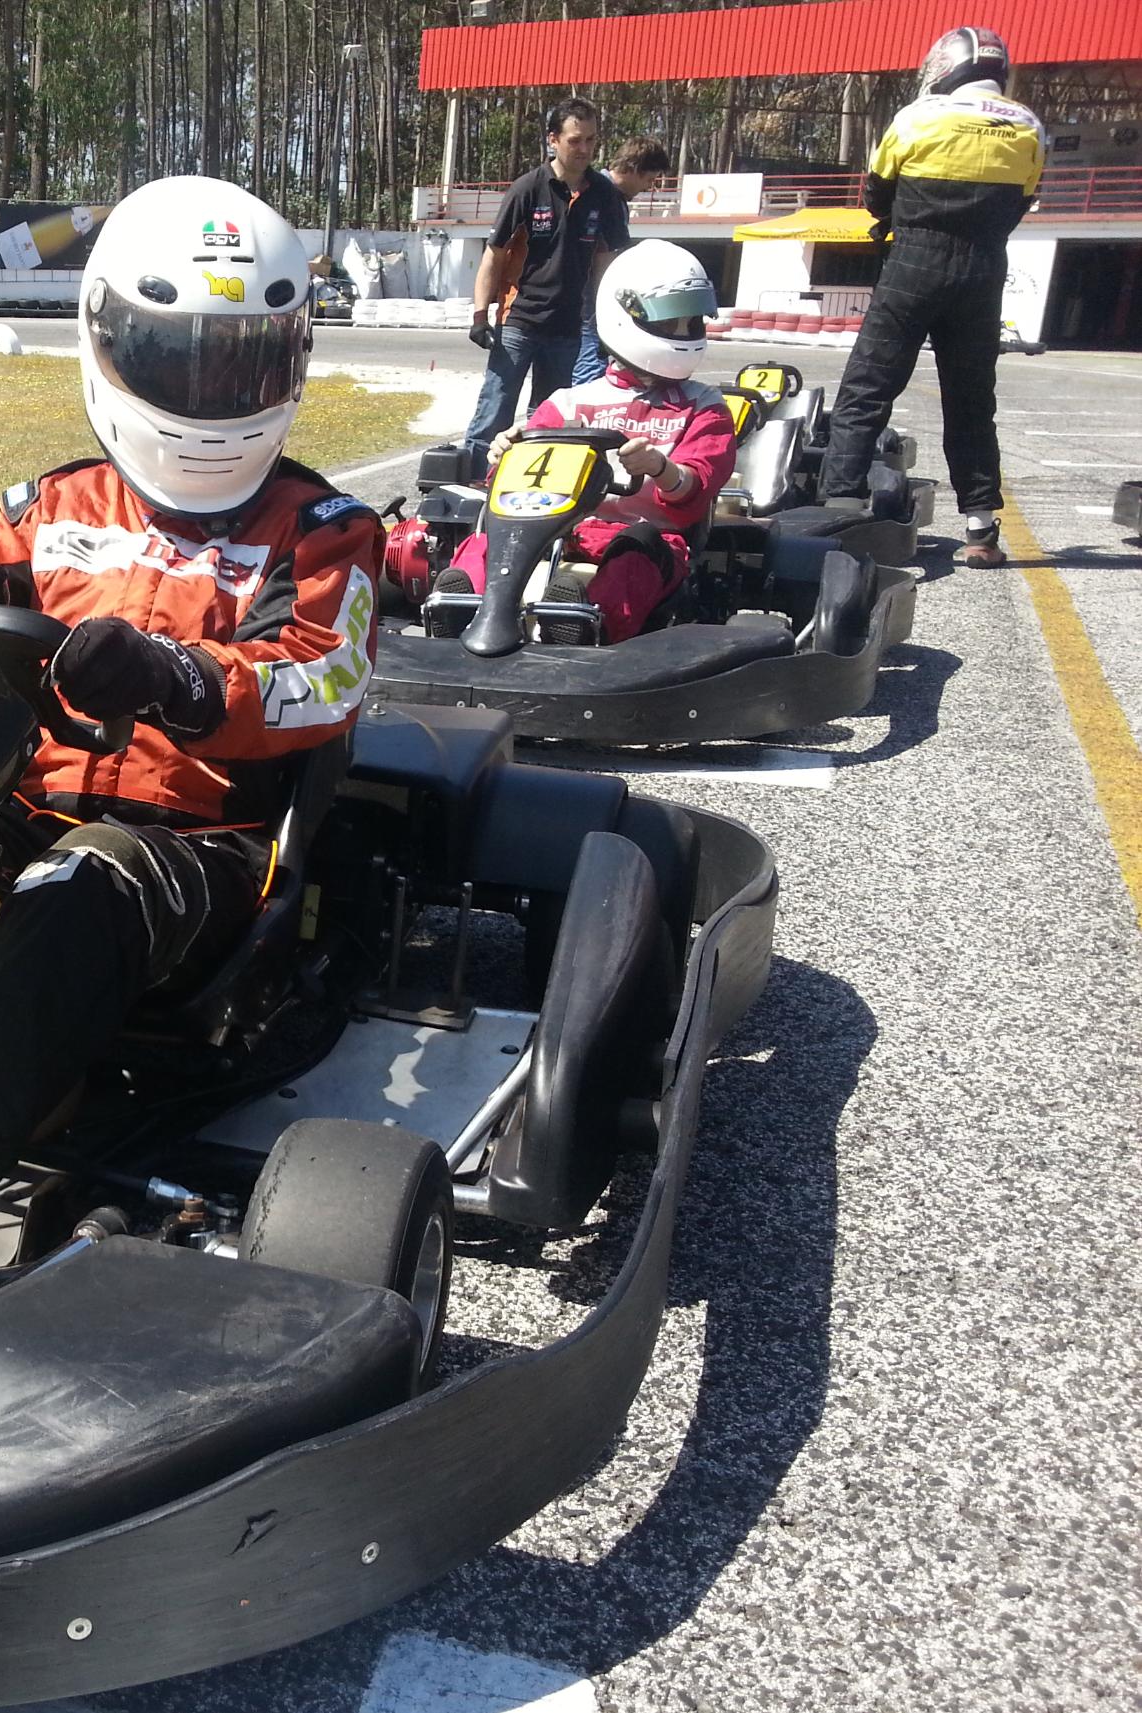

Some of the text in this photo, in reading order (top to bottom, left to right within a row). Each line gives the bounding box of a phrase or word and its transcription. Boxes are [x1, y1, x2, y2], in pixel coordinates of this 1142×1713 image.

[976, 127, 1018, 140] KARTING
[755, 371, 769, 388] 2
[523, 447, 555, 489] 4
[150, 632, 206, 701] sparco
